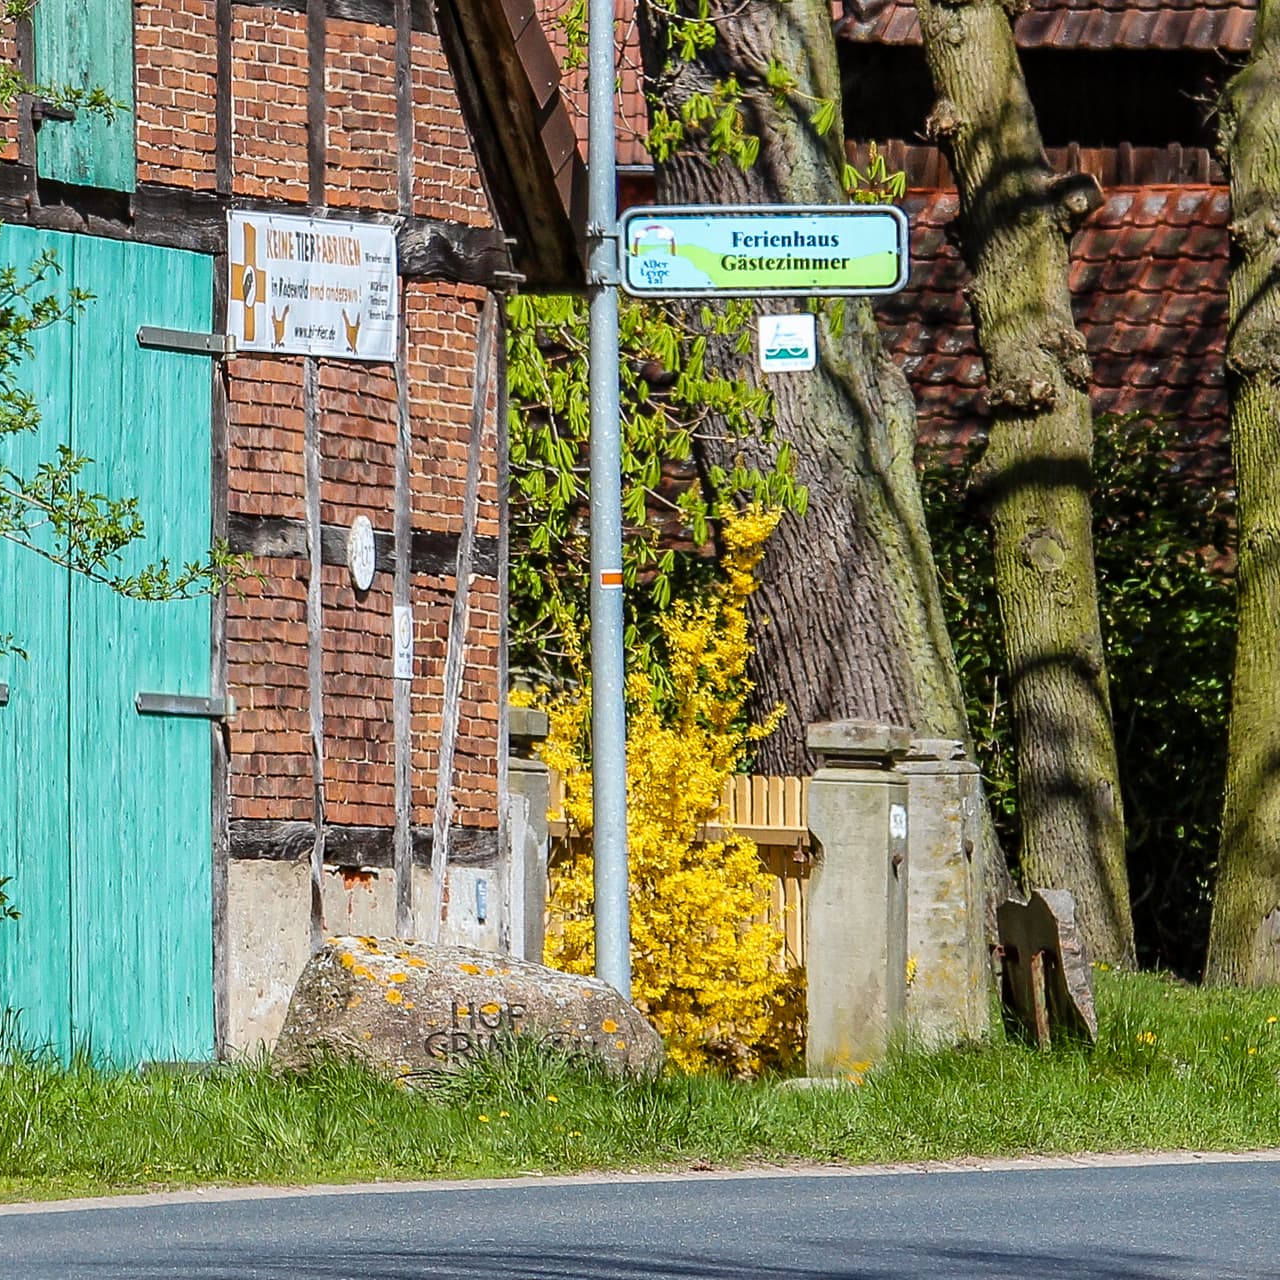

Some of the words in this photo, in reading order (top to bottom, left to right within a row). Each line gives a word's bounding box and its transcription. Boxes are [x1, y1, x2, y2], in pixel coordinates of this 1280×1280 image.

[266, 228, 294, 260] KEINE
[295, 231, 362, 266] TIERFABRIKEN
[731, 230, 840, 248] Ferienhaus
[720, 252, 851, 271] Gästezimmer
[451, 1001, 528, 1031] HOF
